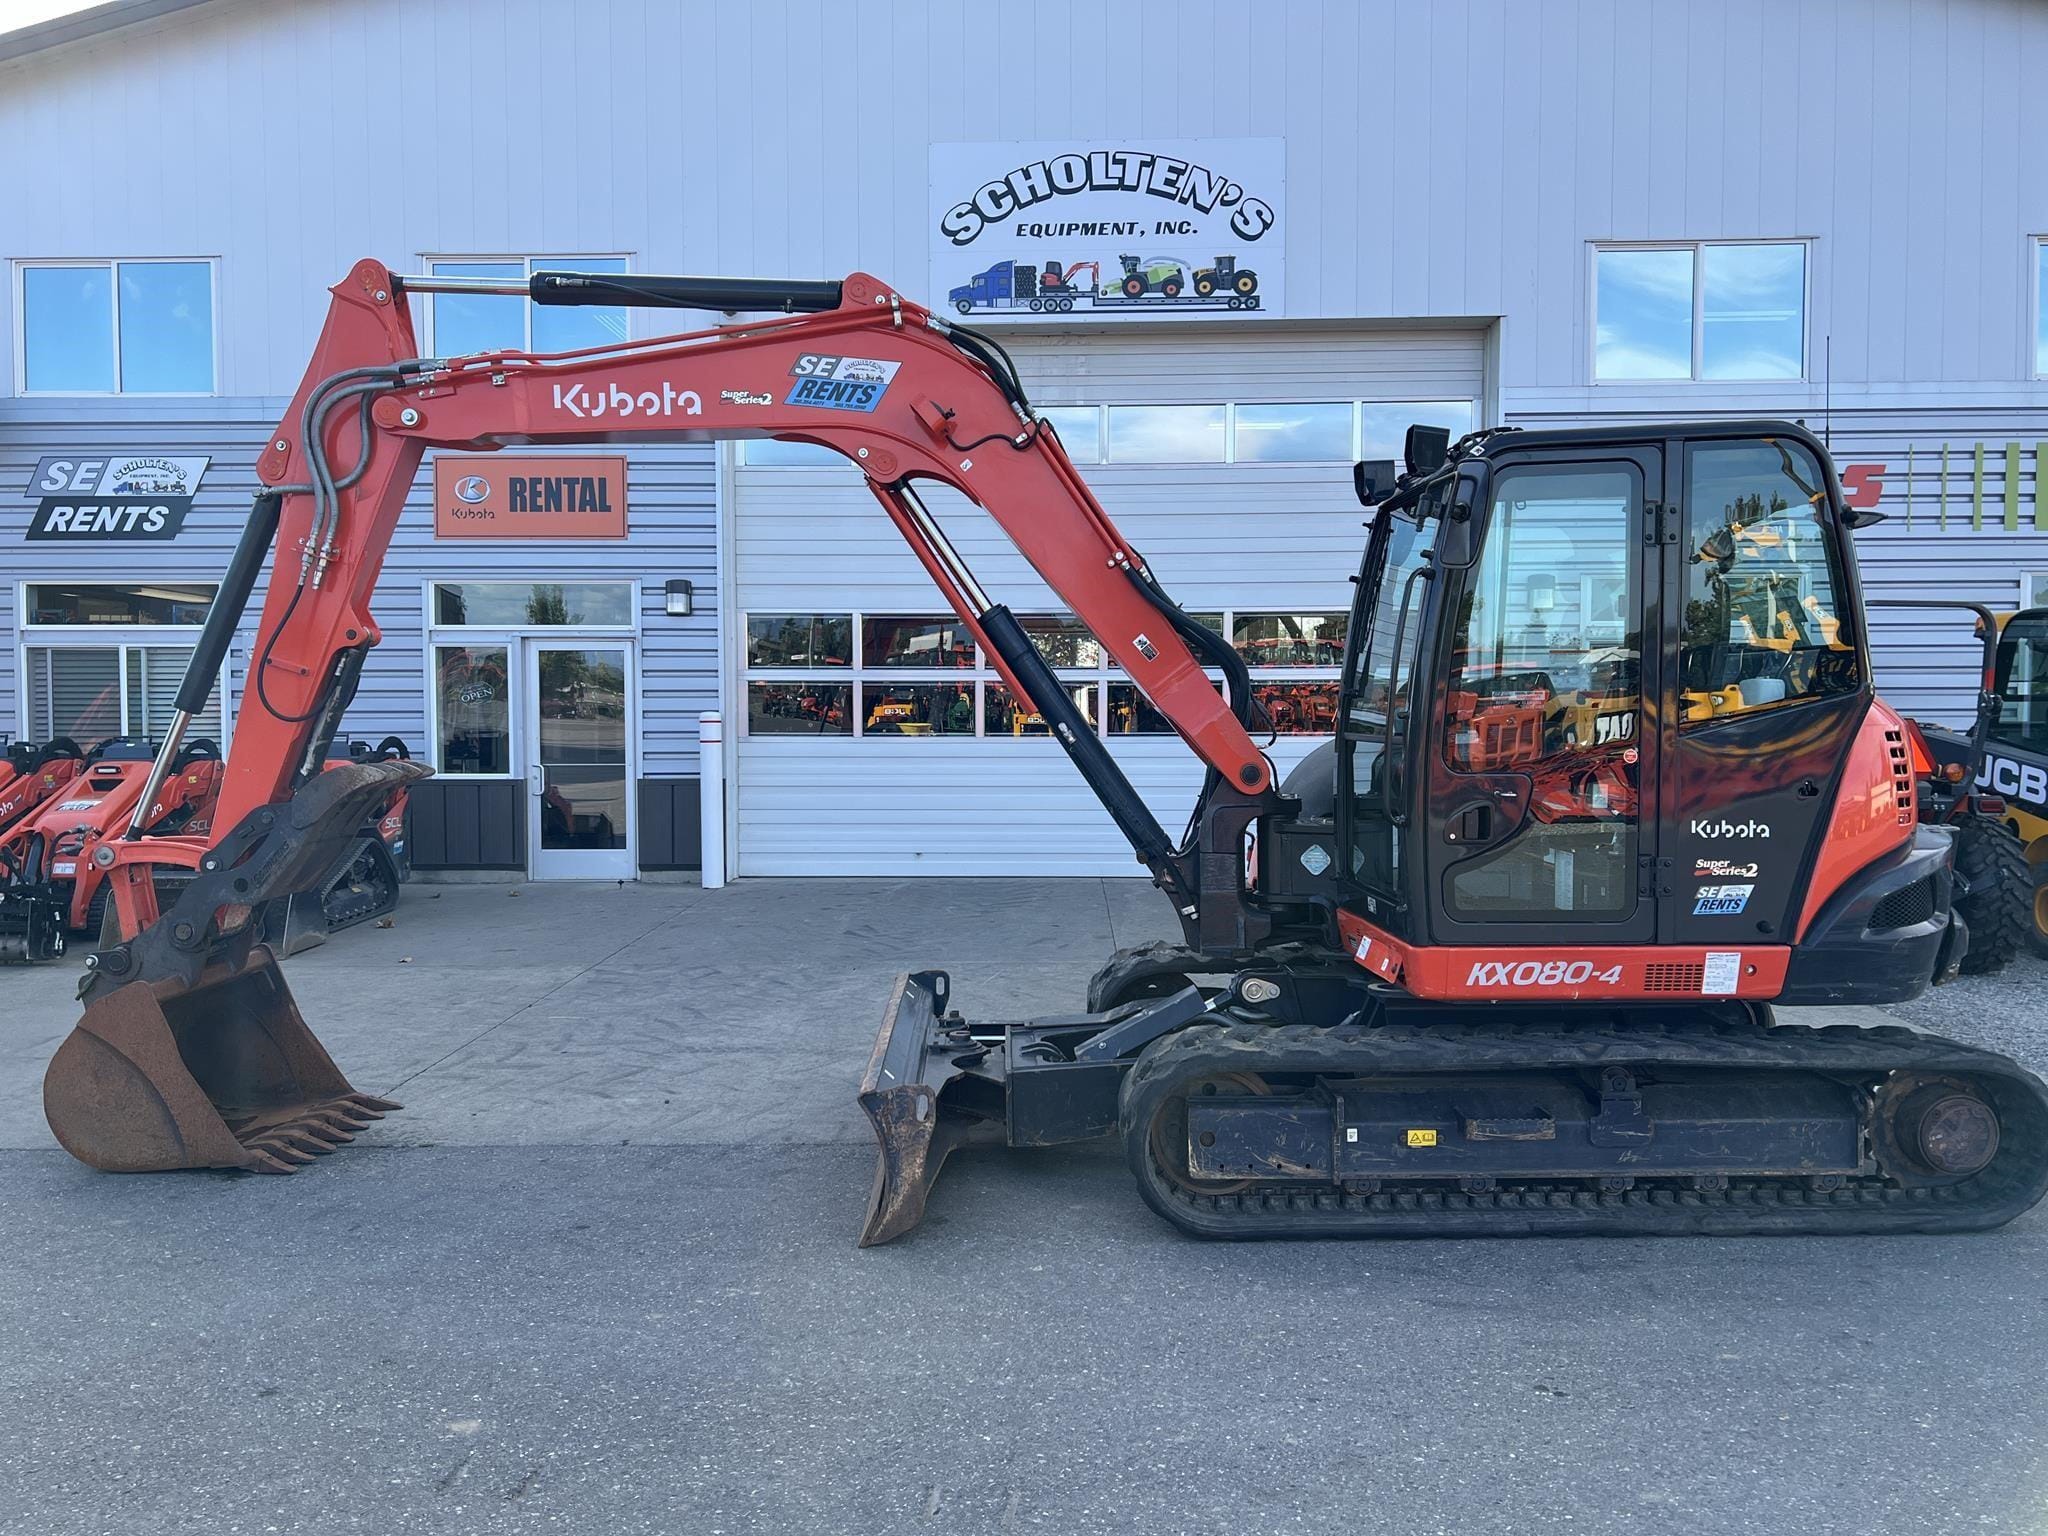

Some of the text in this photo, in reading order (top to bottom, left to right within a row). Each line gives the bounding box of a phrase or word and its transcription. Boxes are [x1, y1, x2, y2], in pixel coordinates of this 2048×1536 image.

[941, 151, 1274, 246] SCHOLTEN'S
[1016, 220, 1199, 238] EQUIPMENT, INC.
[795, 356, 836, 376] SE
[553, 382, 702, 417] Kubota
[720, 390, 749, 400] Super
[796, 379, 877, 404] RENTS
[40, 461, 104, 491] SE
[113, 458, 187, 481] SCHOLTEN'S
[509, 477, 612, 512] RENTAL
[43, 505, 169, 532] RENTS
[452, 508, 495, 519] Kubota
[461, 688, 492, 702] OPEN
[1974, 755, 2047, 805] JCB
[1691, 820, 1770, 838] Kubota
[1696, 859, 1730, 869] Super
[1697, 886, 1720, 898] SE
[1700, 899, 1743, 910] RENTS
[1466, 961, 1624, 987] KX080-4
